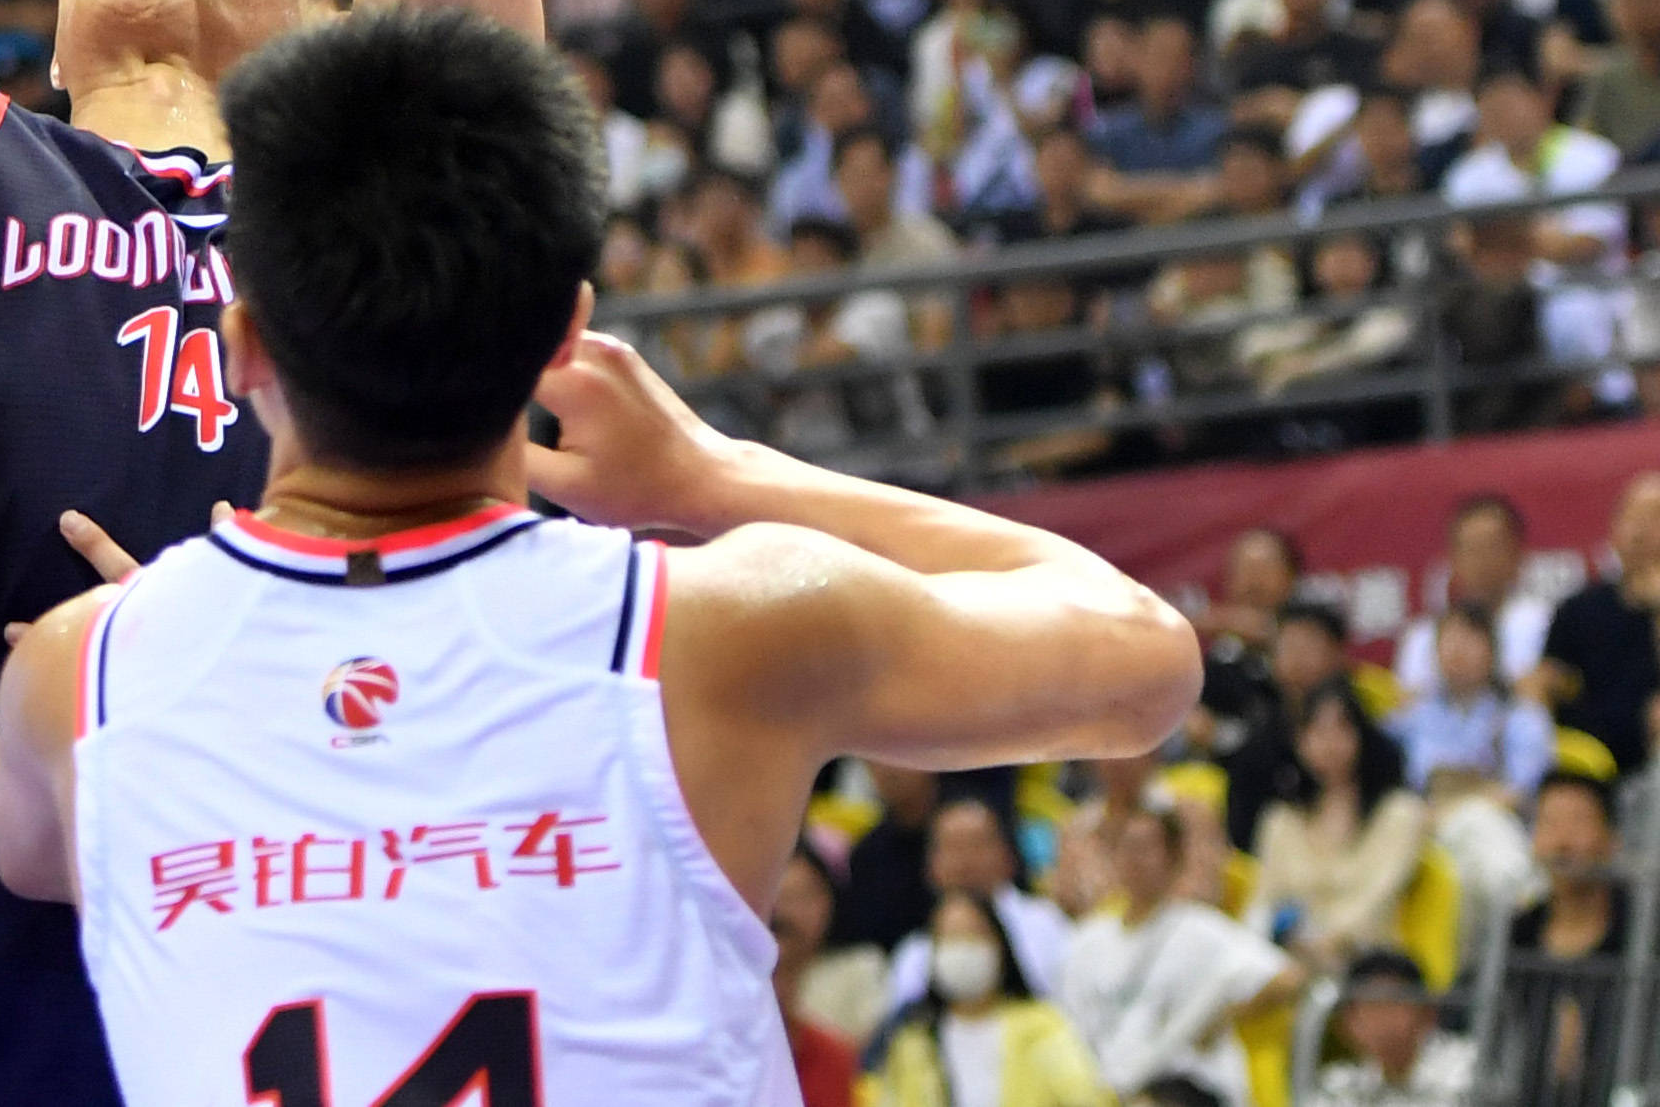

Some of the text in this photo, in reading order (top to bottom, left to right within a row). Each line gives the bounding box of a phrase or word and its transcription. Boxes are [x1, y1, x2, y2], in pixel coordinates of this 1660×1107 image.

[117, 305, 239, 452] 14
[150, 811, 622, 932] 昊铂汽车
